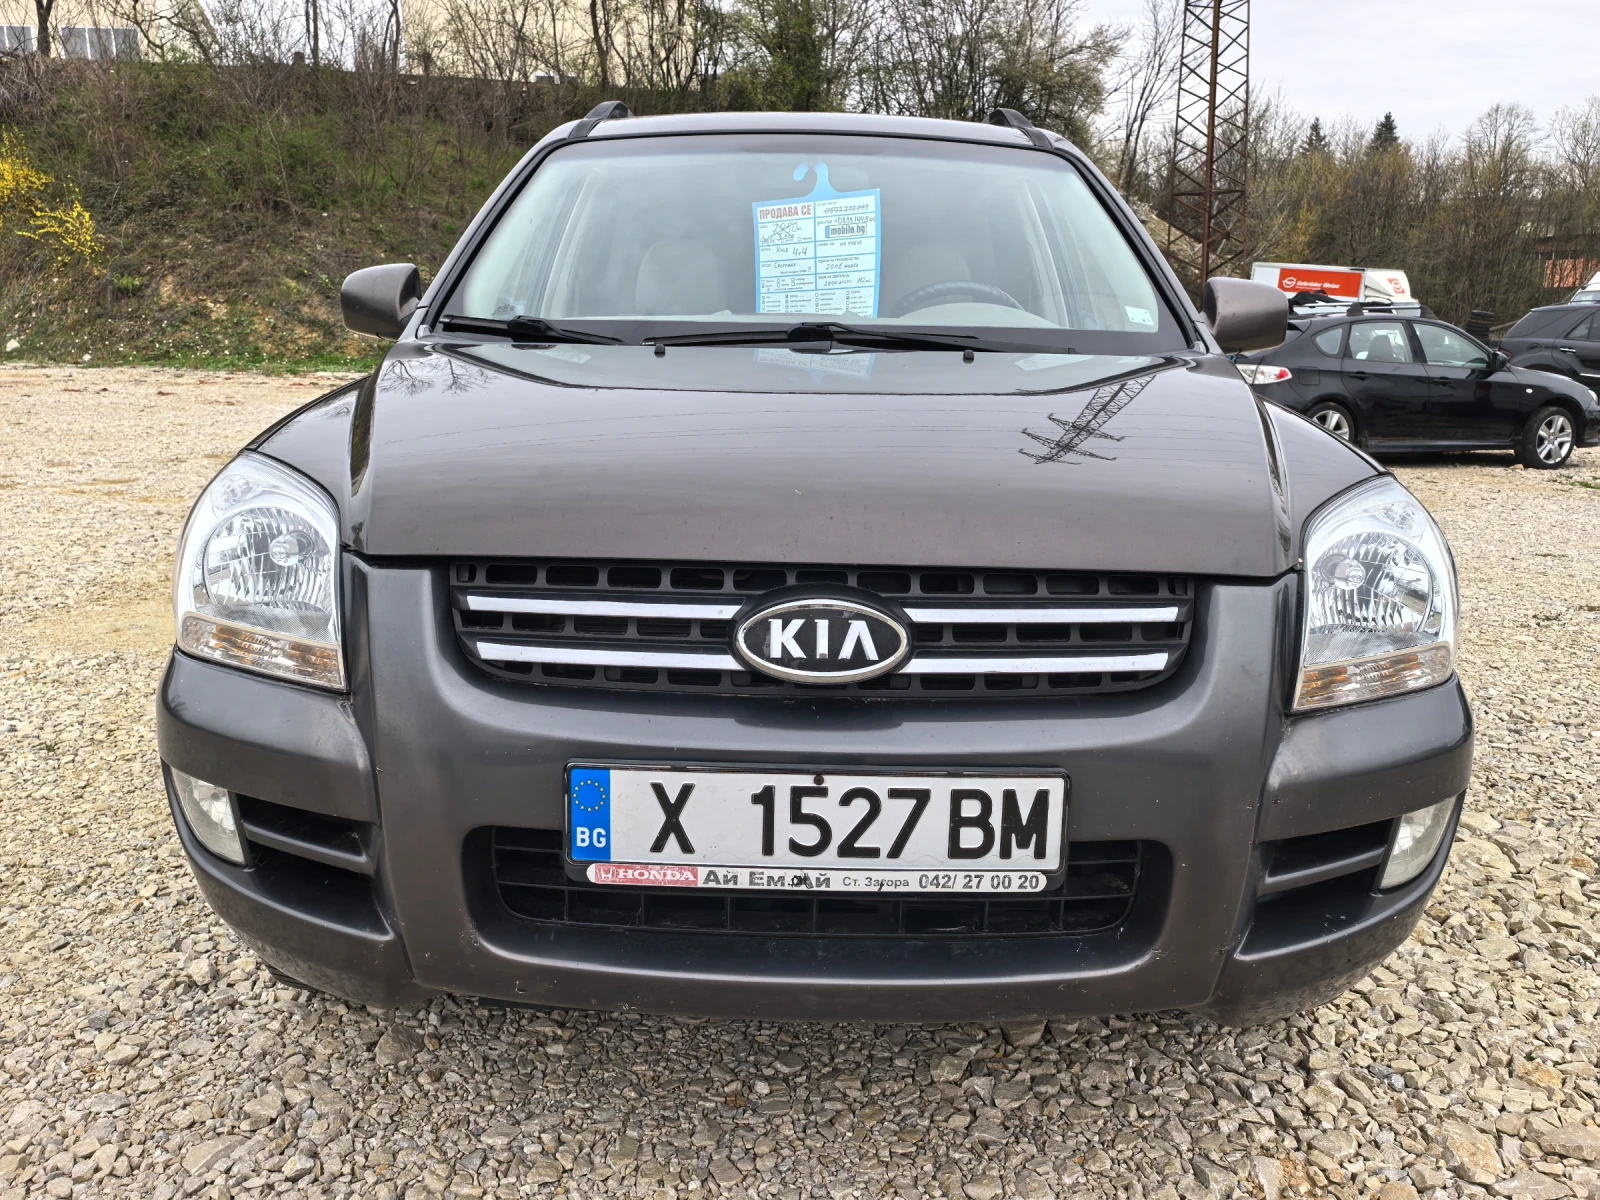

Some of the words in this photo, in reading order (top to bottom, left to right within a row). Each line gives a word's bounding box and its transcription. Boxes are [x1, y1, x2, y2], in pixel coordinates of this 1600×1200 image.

[759, 205, 799, 220] ПРОДАВА
[801, 204, 812, 216] СЕ
[830, 225, 866, 236] mobile.bg
[768, 618, 879, 661] KIA
[649, 781, 696, 855] X
[751, 784, 931, 859] 1527
[947, 788, 1051, 860] BM
[576, 827, 607, 848] BG
[618, 868, 697, 881] HONDA
[702, 869, 739, 886] Ай
[842, 876, 861, 887] Ст.
[864, 876, 910, 891] Загора
[918, 874, 958, 889] 042/
[962, 874, 985, 889] 27
[990, 874, 1012, 890] 00
[1017, 875, 1040, 890] 20
